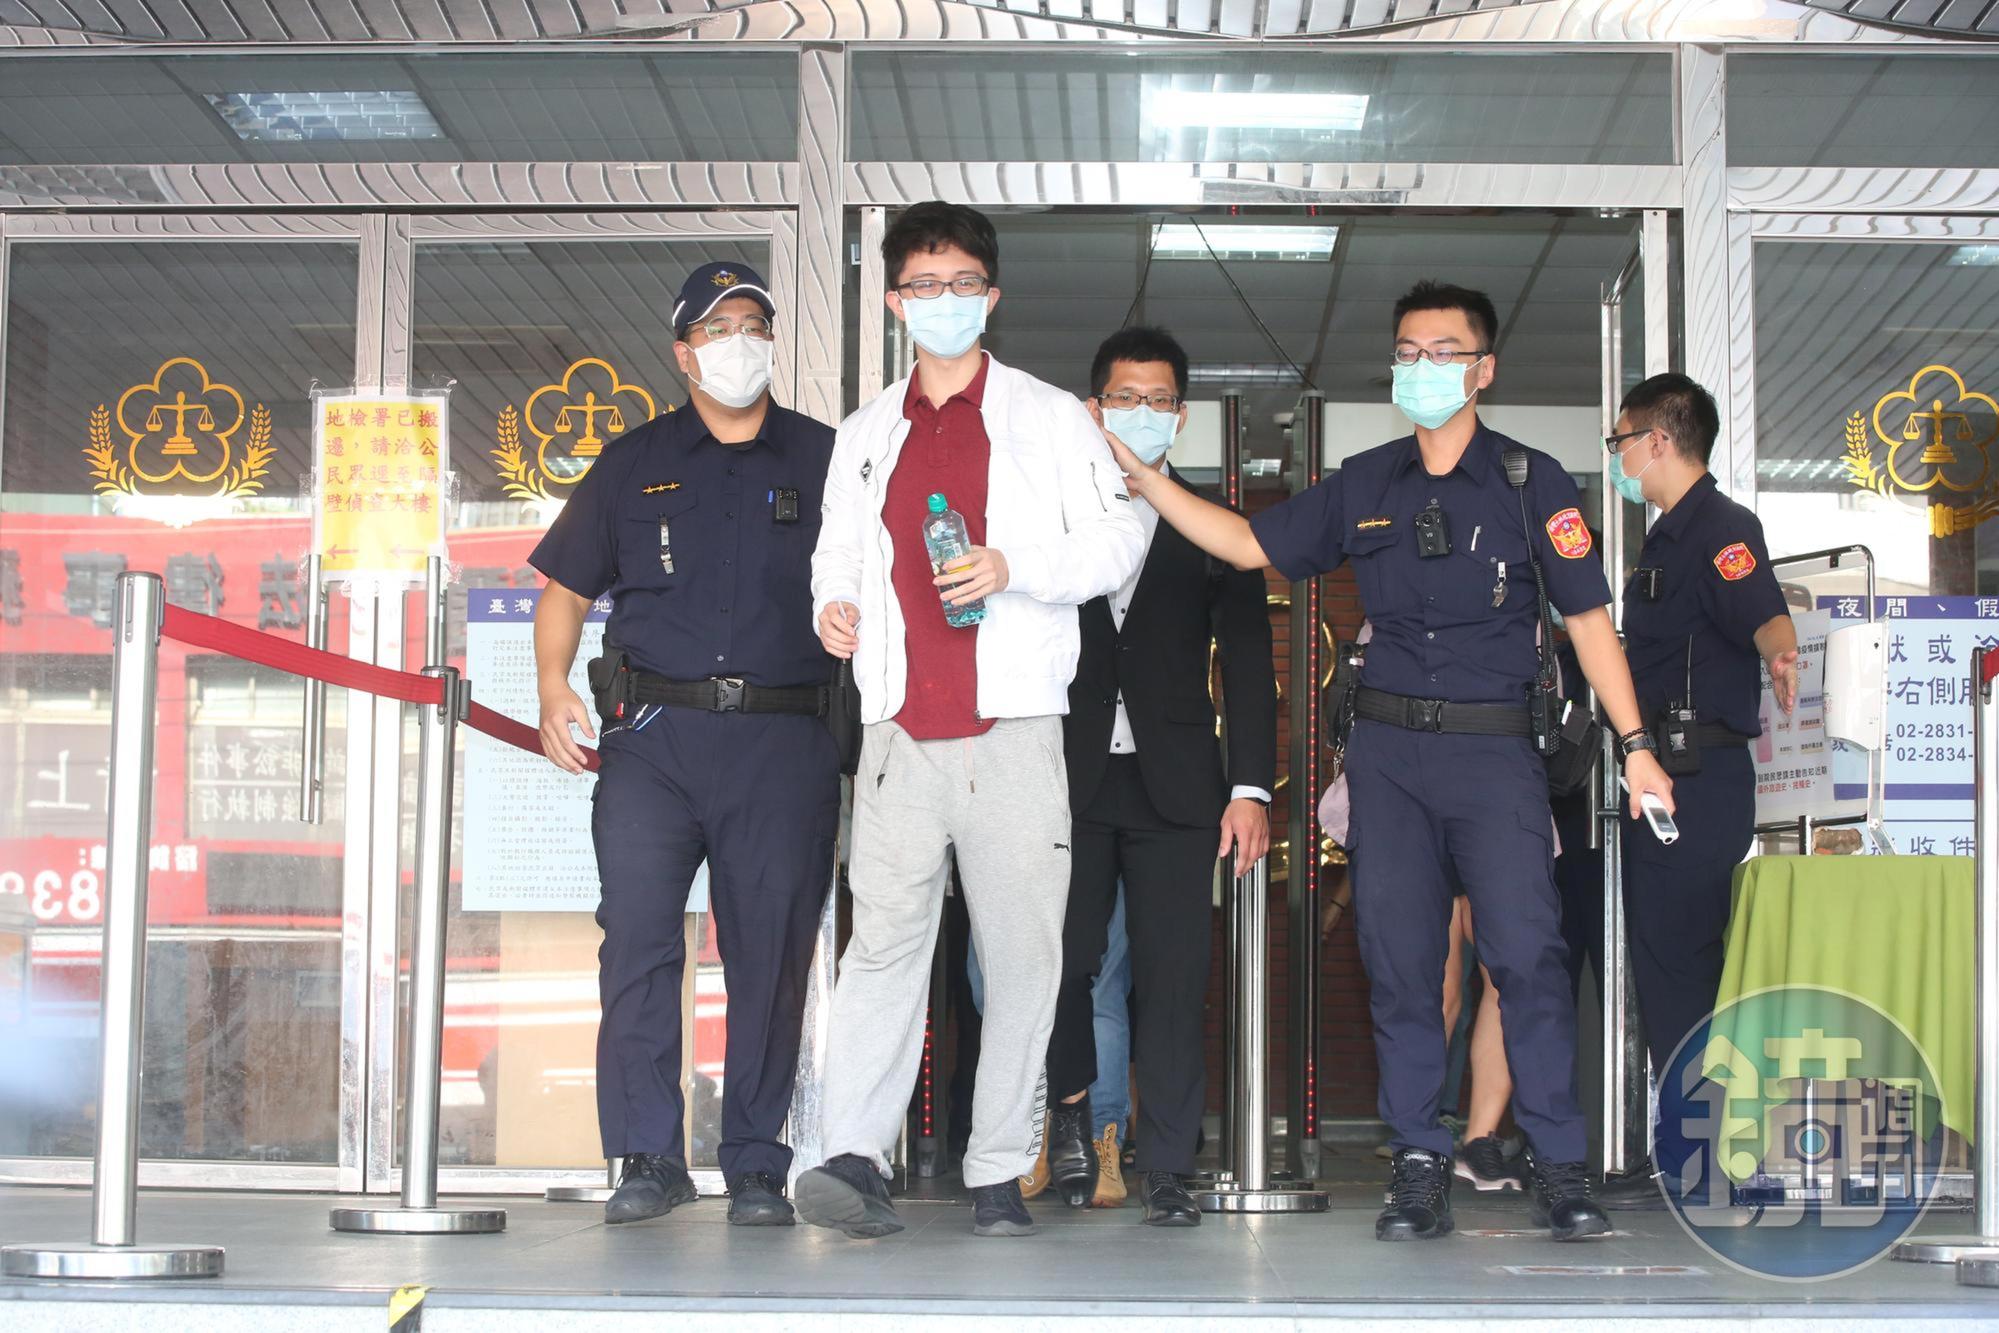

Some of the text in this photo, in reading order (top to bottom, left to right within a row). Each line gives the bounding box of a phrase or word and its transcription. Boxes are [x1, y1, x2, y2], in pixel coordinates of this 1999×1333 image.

[325, 408, 438, 428] 地檢署已搬
[325, 437, 438, 456] 遷，請洽公
[488, 598, 613, 615] 臺灣地
